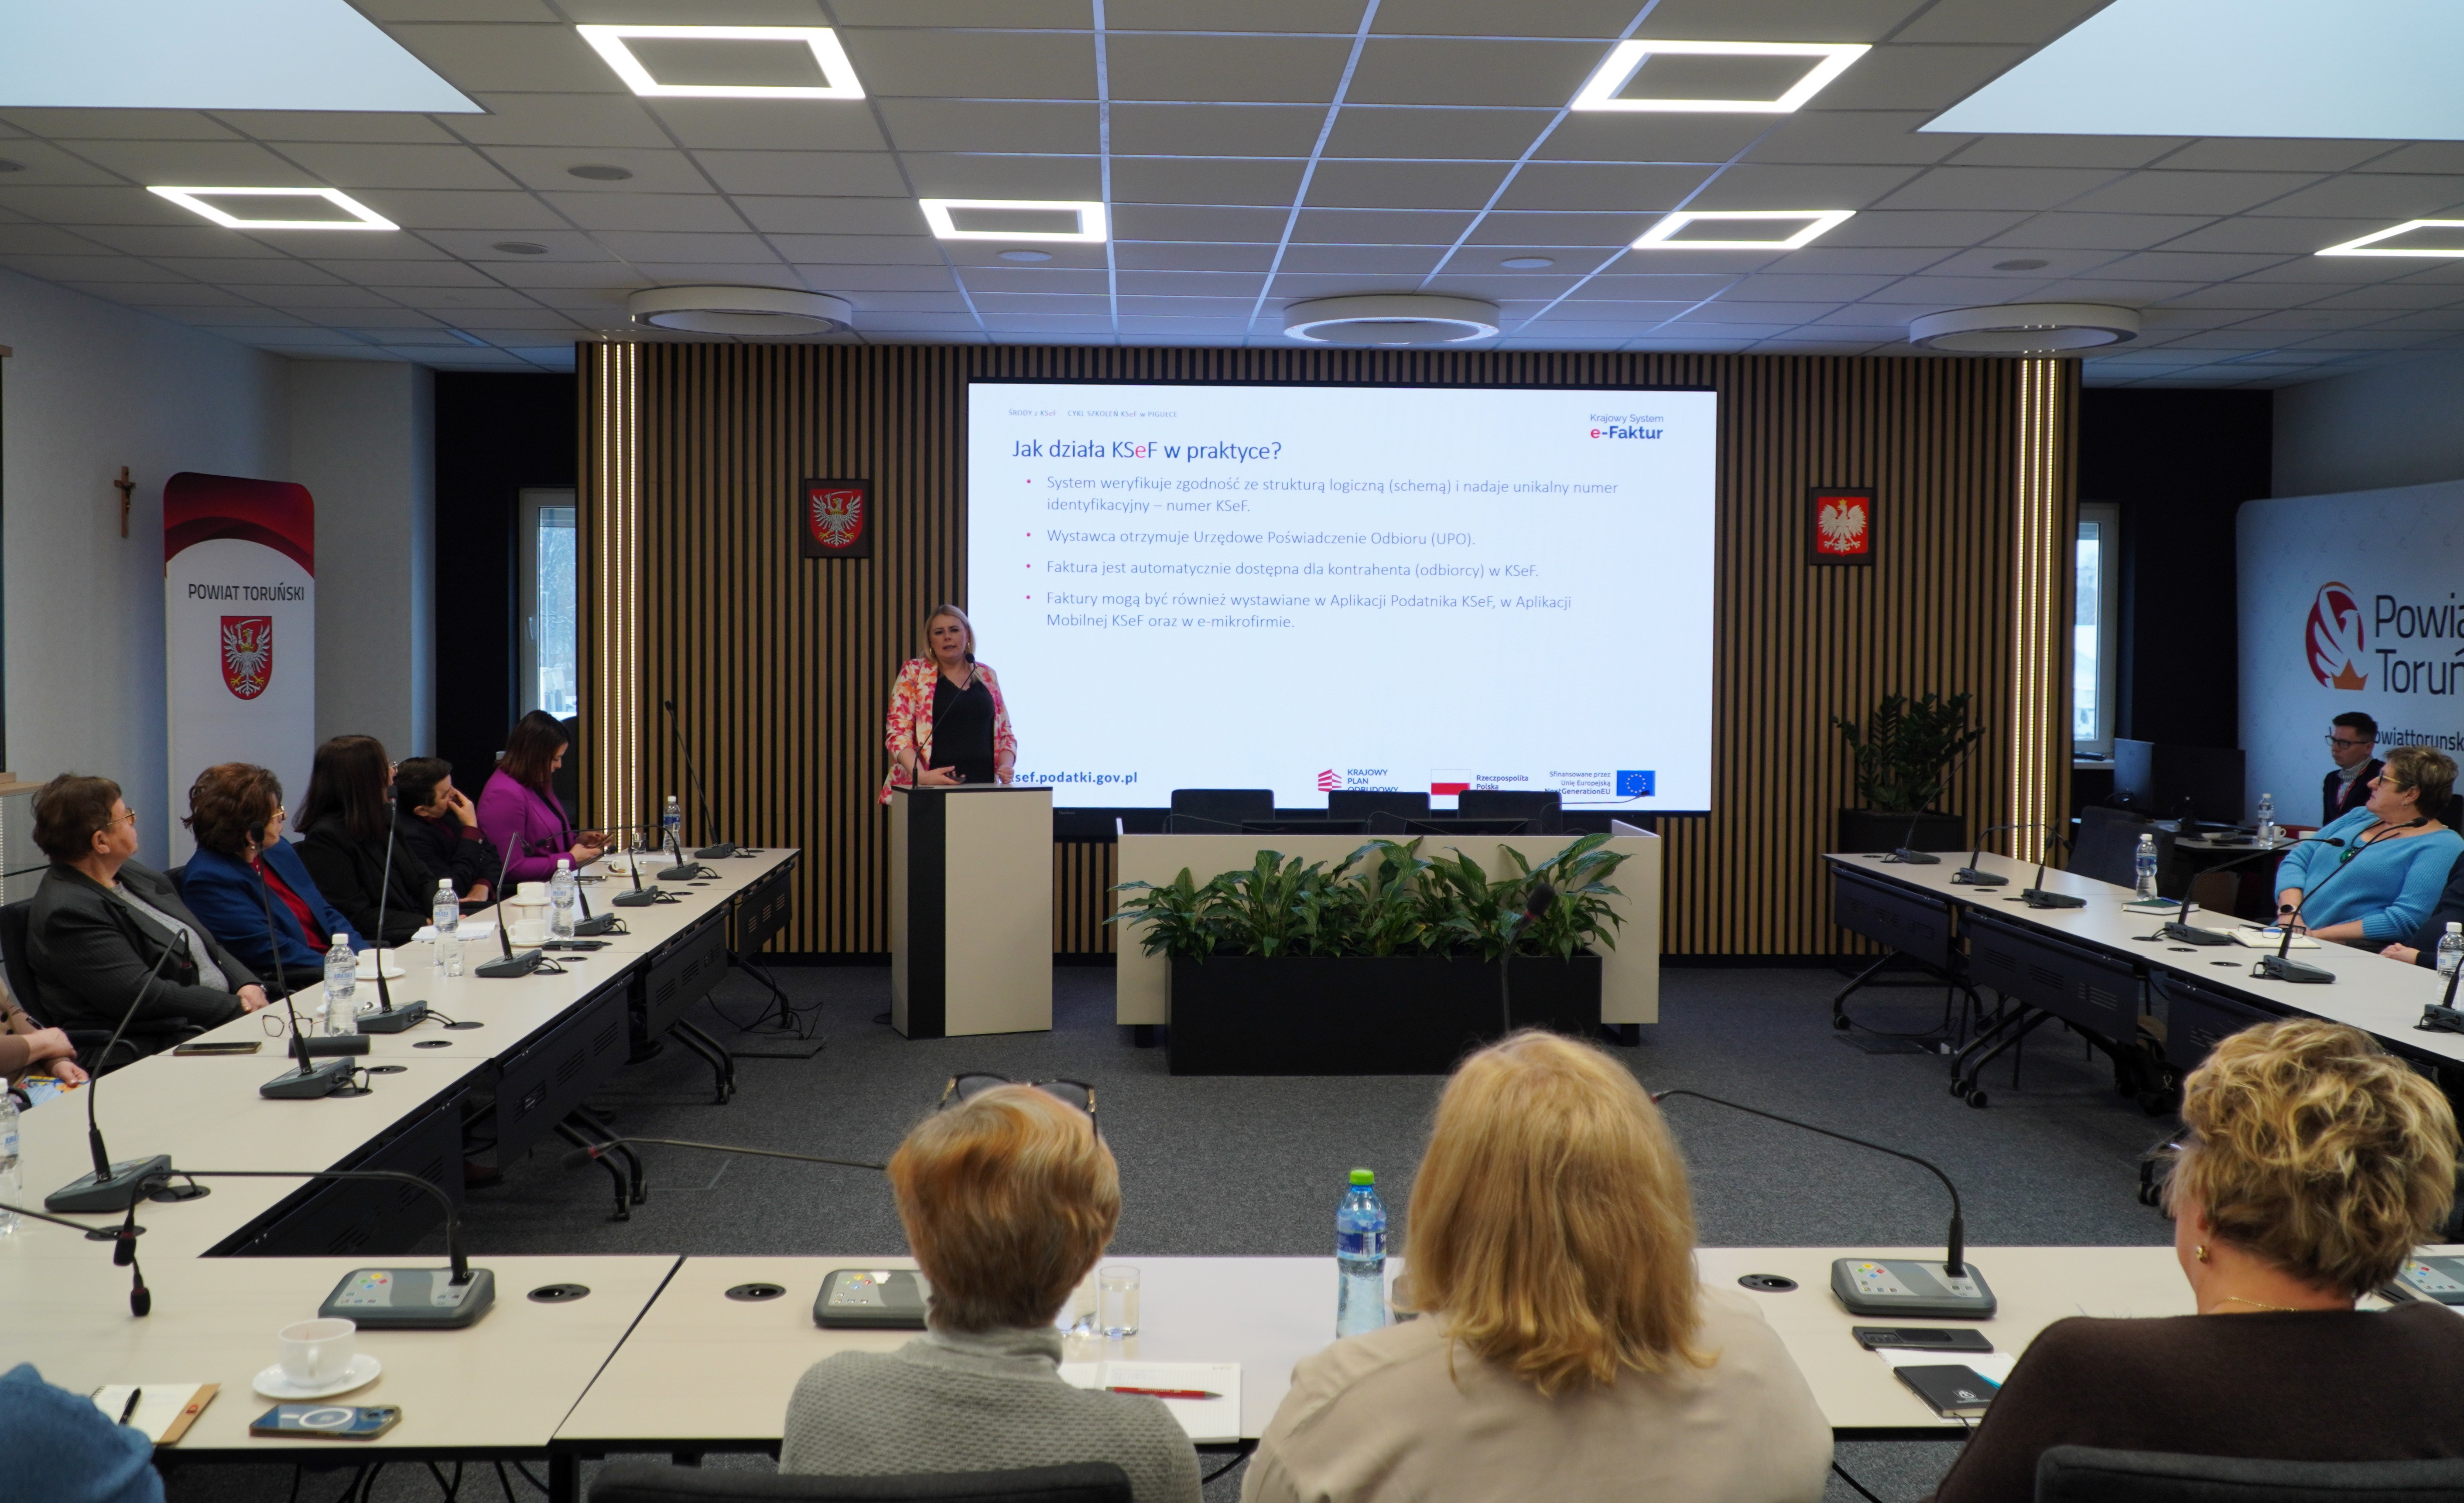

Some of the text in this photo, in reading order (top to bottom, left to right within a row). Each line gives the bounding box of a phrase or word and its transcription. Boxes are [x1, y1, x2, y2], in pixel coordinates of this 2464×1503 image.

[1590, 414, 1664, 424] Krajowy System
[1590, 425, 1663, 440] e-Faktur
[1012, 438, 1282, 464] Jak działa KSeF w praktyce?
[1047, 476, 1095, 491] System
[1100, 476, 1172, 492] weryfikuje
[1176, 477, 1240, 492] zgodność
[1244, 481, 1258, 490] ze
[1263, 478, 1325, 493] strukturą
[1330, 478, 1384, 494] logiczną
[1389, 479, 1451, 495] (schemą)
[1464, 480, 1509, 495] nadaje
[1514, 480, 1569, 495] unikalny
[1574, 484, 1619, 494] numer
[1047, 497, 1150, 513] identyfikacyjny
[1167, 502, 1212, 512] numer
[1217, 500, 1250, 512] KSeF.
[1047, 529, 1475, 547] Wystawca otrzymuje Urzędowe Poświadczenie Odbioru (UPO).
[1047, 560, 1538, 579] Faktura jest automatycznie dostępna dla kontrahenta (odbiorcy) w KSeF.
[188, 582, 305, 601] POWIAT TORUŃSKI
[1047, 591, 1571, 611] Faktury mogą być również wystawiane w Aplikacji Podatnika KSeF, w Aplikacji
[1047, 613, 1294, 629] Mobilnej KSeF oraz w e-mikrofirmie.
[2375, 727, 2464, 752] owiattorunsk
[1012, 771, 1138, 785] sef.podatki.gov.pl
[1476, 774, 1529, 782] Rzeczpospolita
